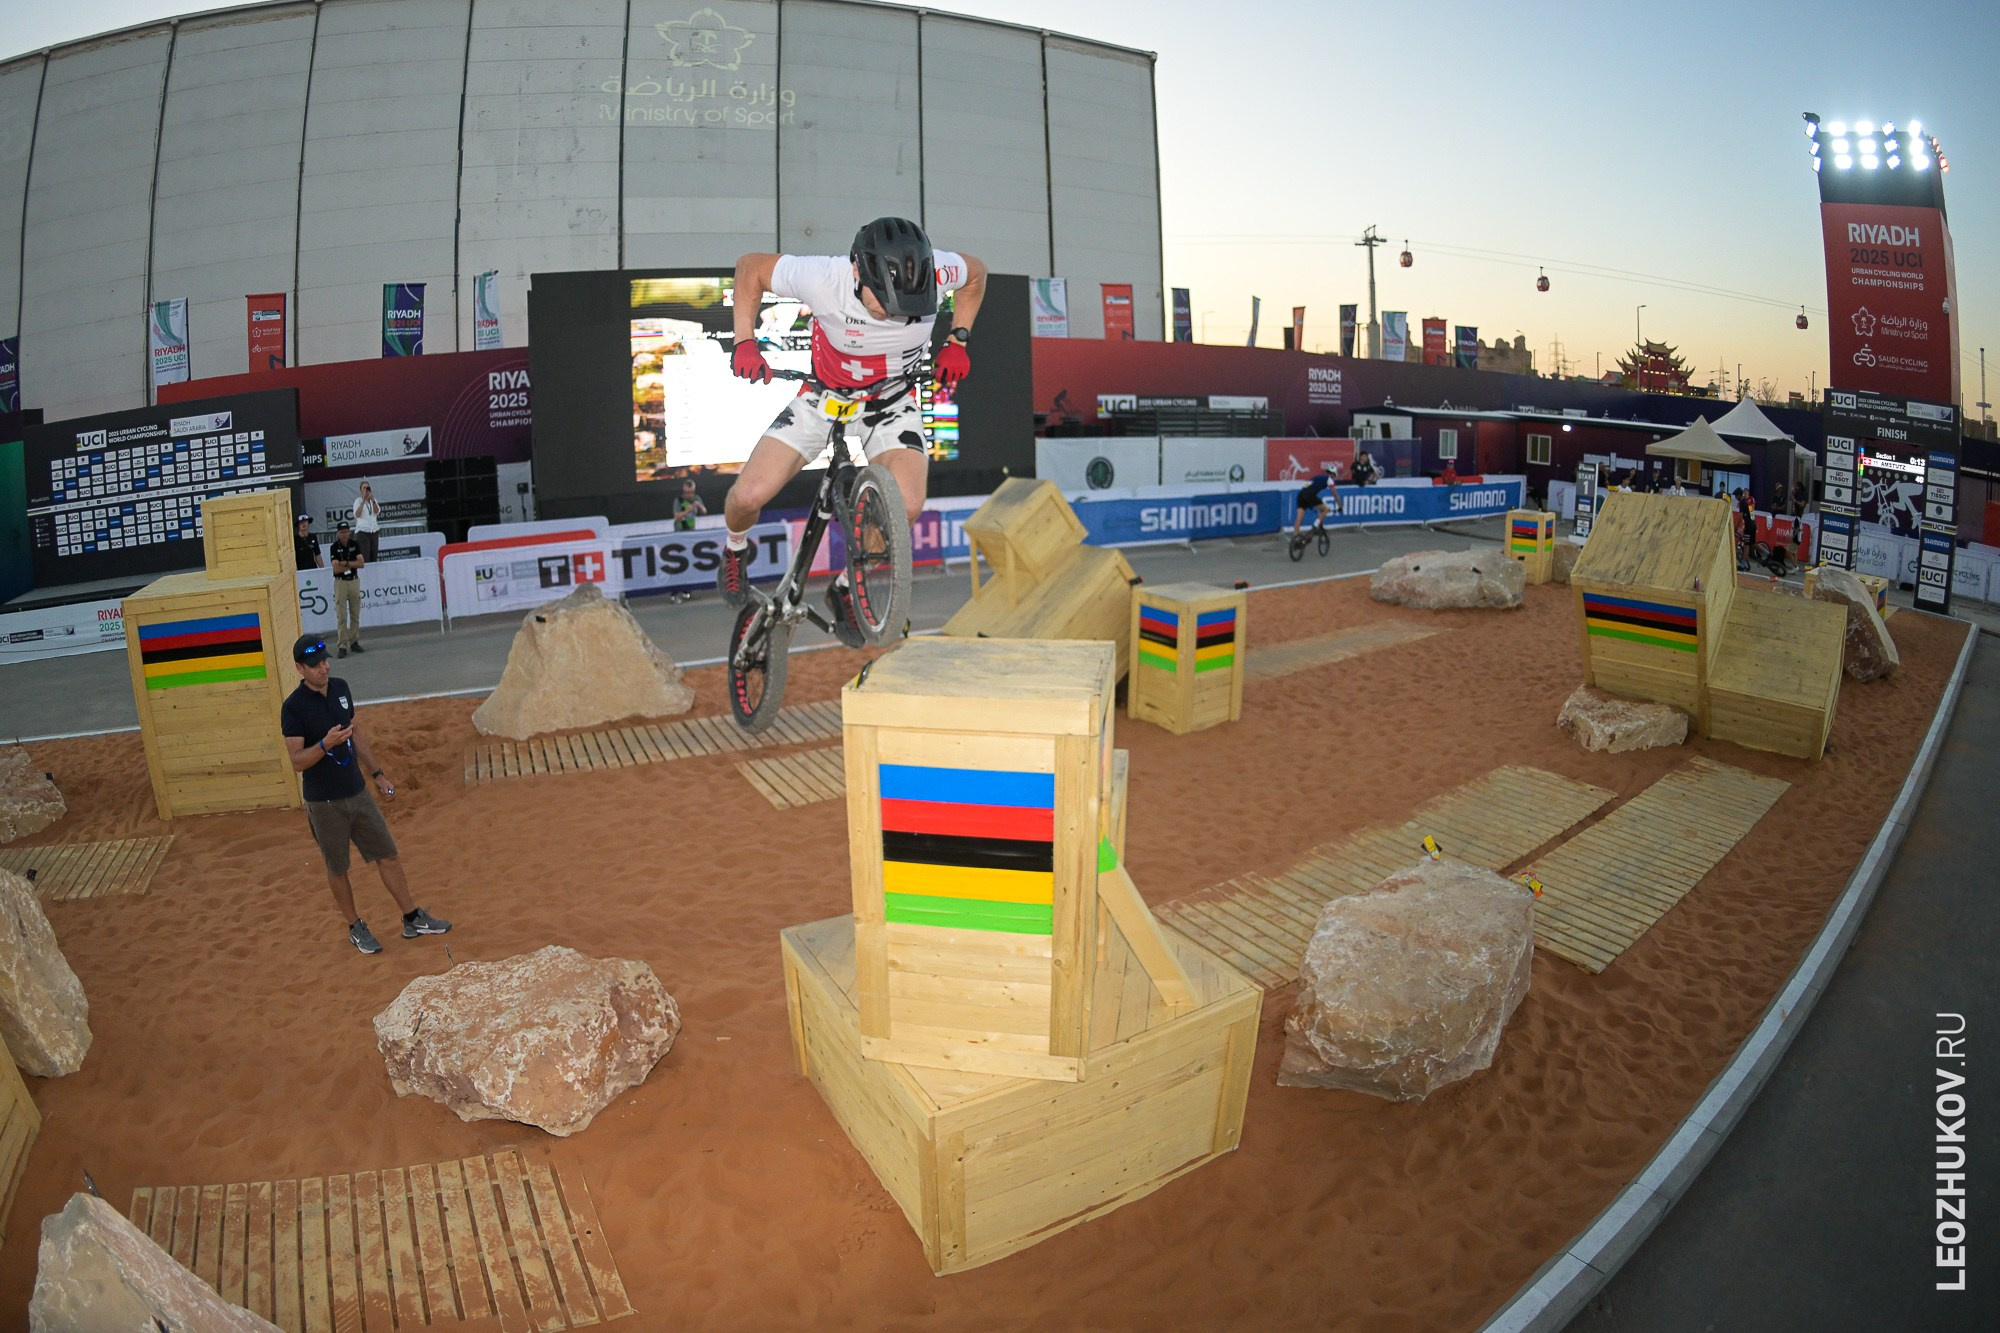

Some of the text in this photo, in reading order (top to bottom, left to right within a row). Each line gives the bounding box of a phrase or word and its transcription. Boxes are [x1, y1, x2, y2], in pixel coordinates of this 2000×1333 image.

[601, 104, 795, 127] Ministry of Sport
[1848, 223, 1920, 247] RIYADH
[1850, 248, 1922, 268] 2025 UCI
[1852, 277, 1924, 290] CHAMPIONSHIPS
[388, 310, 421, 318] RIYADH
[1881, 327, 1903, 338] Ministry
[1911, 331, 1928, 339] Sport
[154, 344, 185, 357] RIYADH
[155, 356, 172, 365] 2025
[1878, 355, 1928, 367] SAUDI CYCLING
[1308, 368, 1341, 381] RIYADH
[1308, 382, 1341, 393] 2025 UCI
[490, 393, 528, 408] 2025
[1104, 400, 1134, 413] UCI
[1836, 396, 1854, 406] UCI
[127, 430, 167, 440] CHAMPIONSHIPS
[1878, 427, 1907, 440] FINISH
[82, 434, 104, 447] UCI
[331, 440, 361, 450] RIYADH
[1833, 439, 1851, 450] UCI
[331, 448, 389, 461] SAUDI ARABIA
[1929, 454, 1954, 464] SHIMANO
[1881, 462, 1906, 470] AMSTUTZ
[1584, 481, 1589, 495] 1
[1450, 490, 1507, 510] SHIMANO
[1931, 492, 1950, 500] TISSOT
[1141, 502, 1257, 532] SHIMANO
[1824, 519, 1849, 529] SHIMANO
[1932, 523, 1944, 531] UCI
[1924, 537, 1950, 548] SHIMANO
[1826, 552, 1844, 563] UCI
[1925, 572, 1943, 584] UCI
[374, 583, 426, 598] CYCLING
[100, 622, 120, 632] 2025
